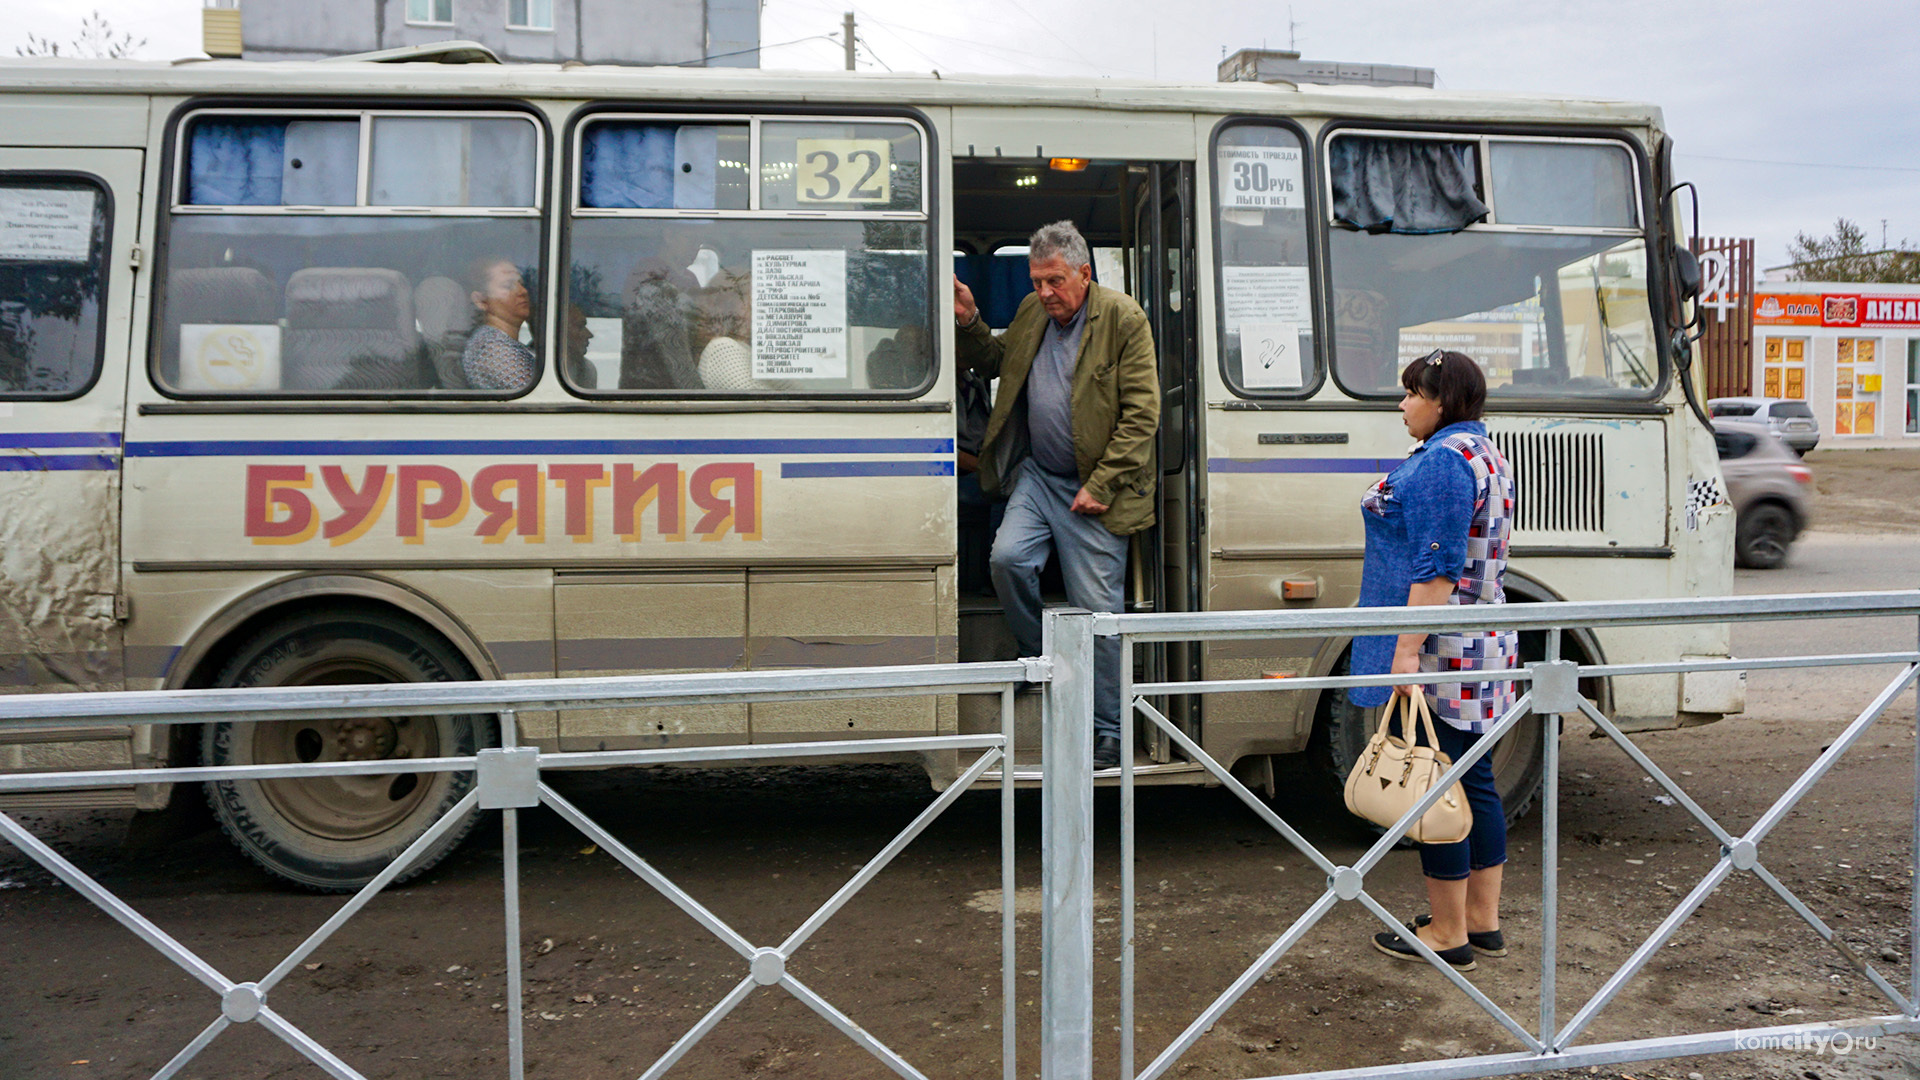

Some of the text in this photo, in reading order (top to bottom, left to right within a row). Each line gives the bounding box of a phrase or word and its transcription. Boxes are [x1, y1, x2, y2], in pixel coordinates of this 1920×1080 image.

[1262, 151, 1298, 161] ПРОЕЗДА
[806, 150, 882, 200] 32
[1234, 162, 1294, 192] 30 РУБ
[1236, 195, 1288, 205] ЛЬГОТ НЕТ
[1788, 304, 1820, 316] ПАПА
[244, 463, 762, 547] БУРЯТИЯ
